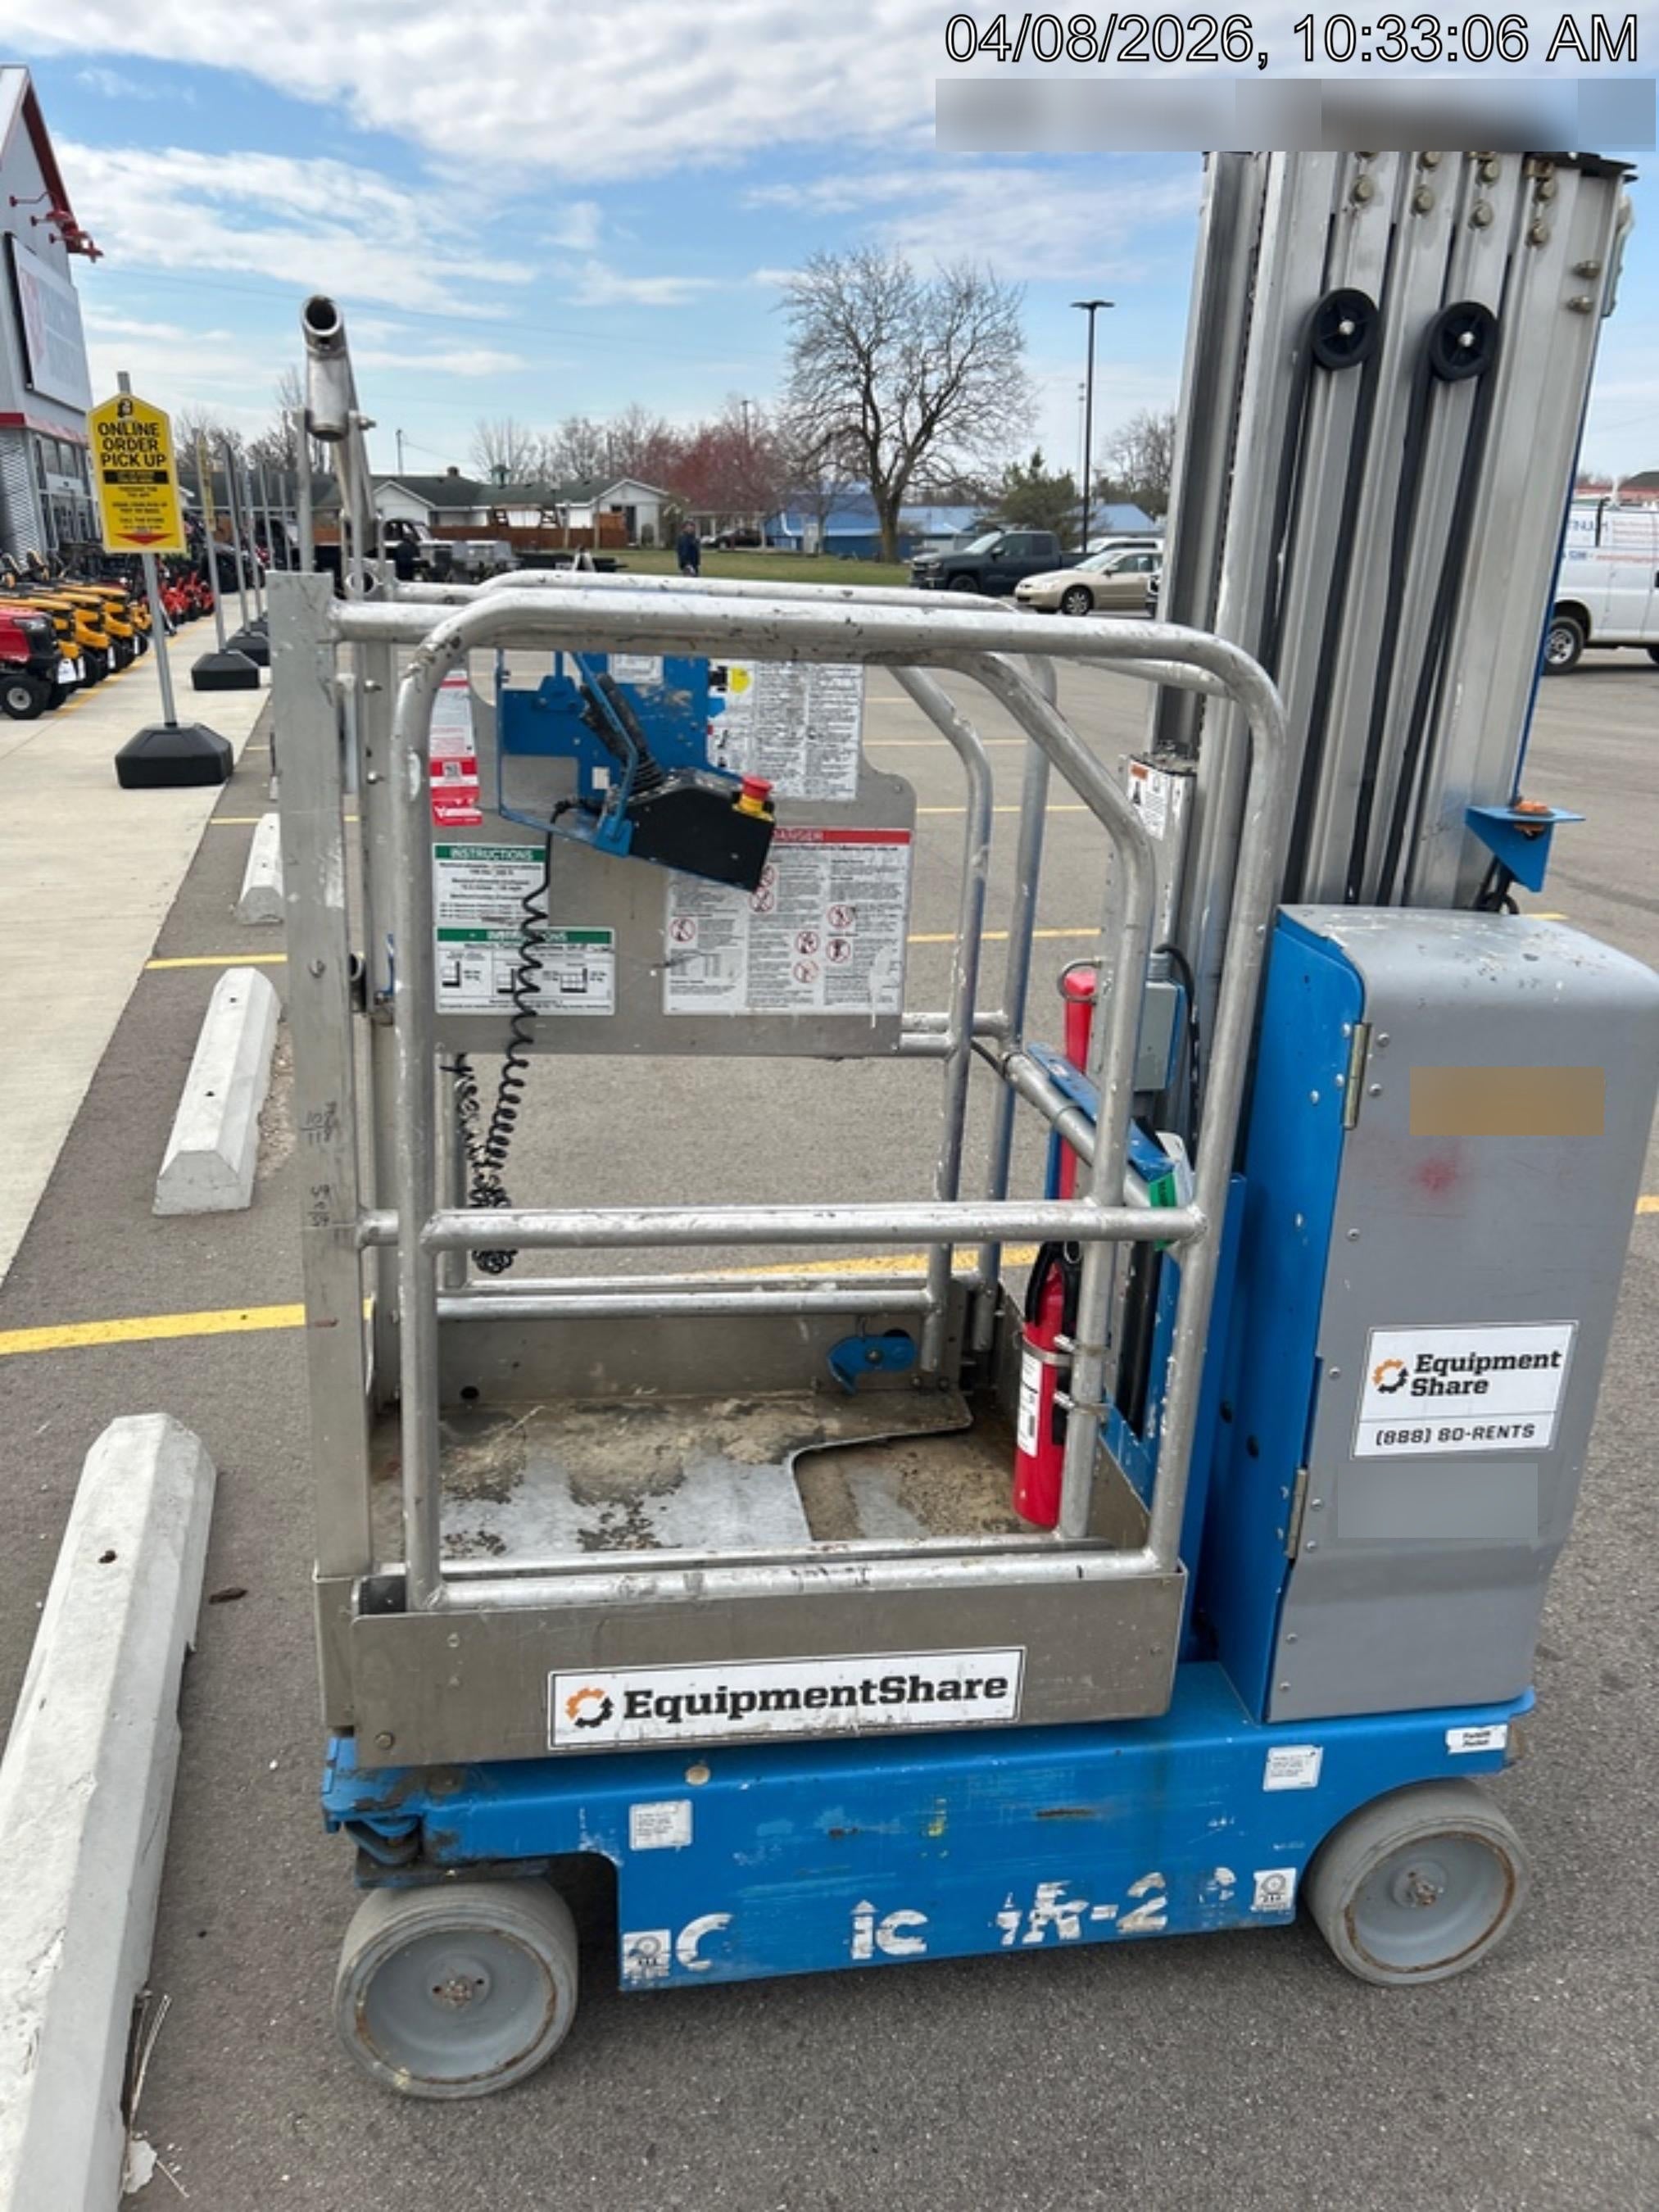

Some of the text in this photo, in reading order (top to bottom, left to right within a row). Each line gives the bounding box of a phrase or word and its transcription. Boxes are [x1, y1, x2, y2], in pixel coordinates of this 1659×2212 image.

[97, 422, 160, 437] ONLINE
[102, 437, 159, 451] ORDER
[102, 452, 167, 468] PICK UP
[450, 846, 533, 861] INSTRUCTIONS
[1415, 1350, 1562, 1377] Equipment
[1410, 1376, 1489, 1397] Share
[1376, 1423, 1536, 1447] (888) 80-RENTS
[623, 1675, 1009, 1722] EquipmentShare
